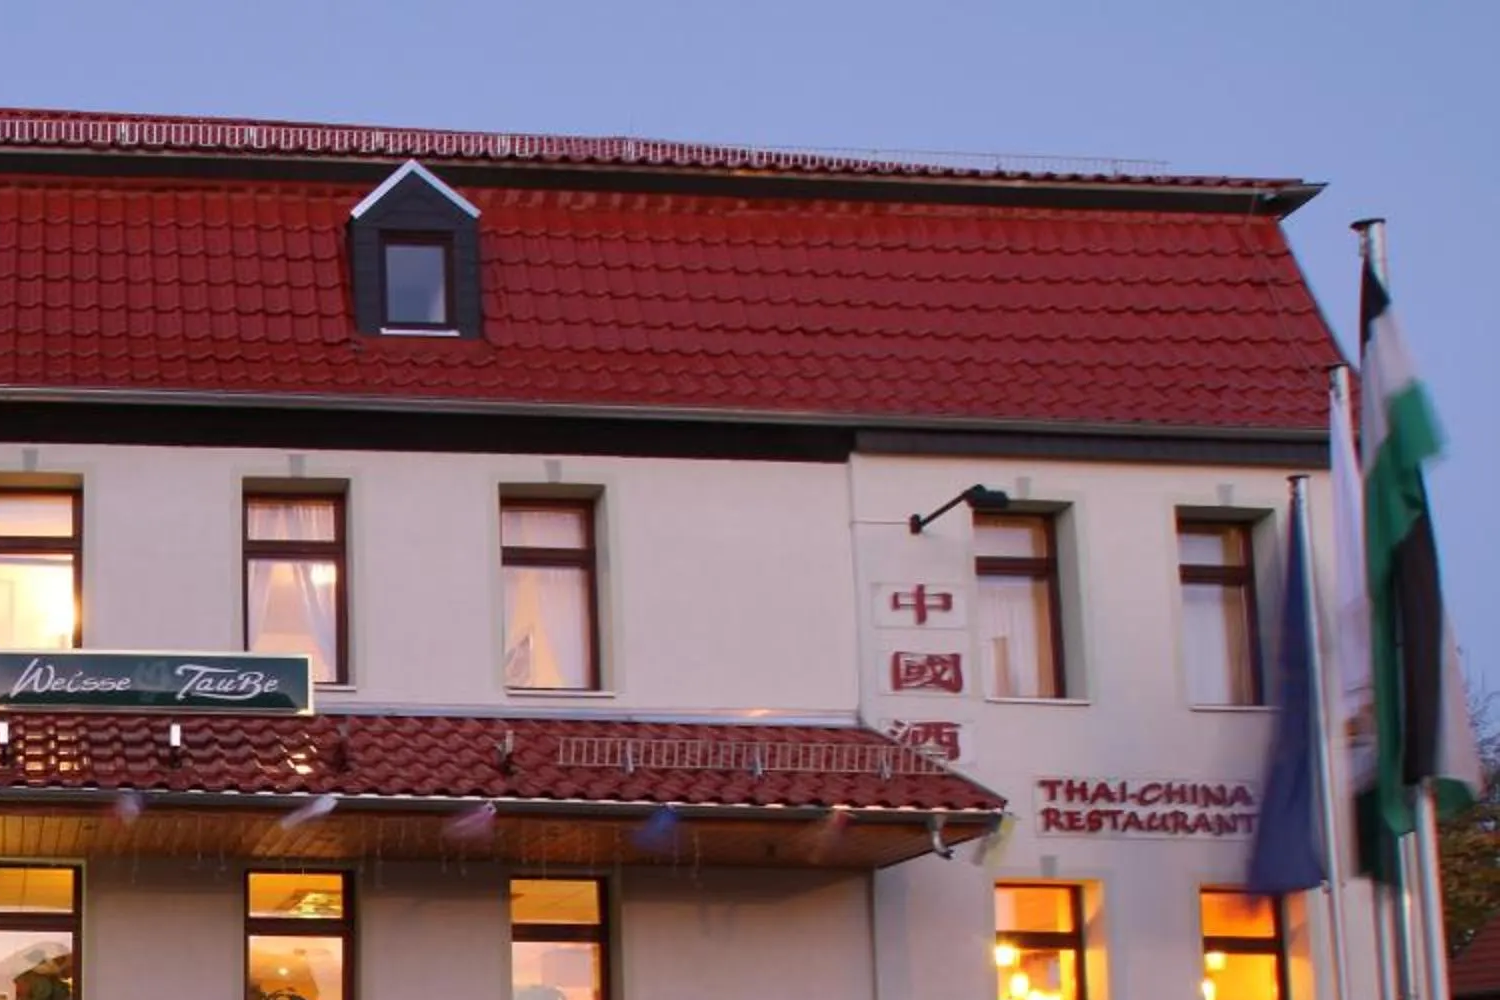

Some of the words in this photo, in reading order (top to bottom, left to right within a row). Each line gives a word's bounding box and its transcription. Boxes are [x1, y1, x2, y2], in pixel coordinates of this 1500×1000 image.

[8, 657, 132, 698] Weisse
[1036, 777, 1255, 808] THAI-CHINA
[1040, 807, 1260, 836] RESTAURANT
